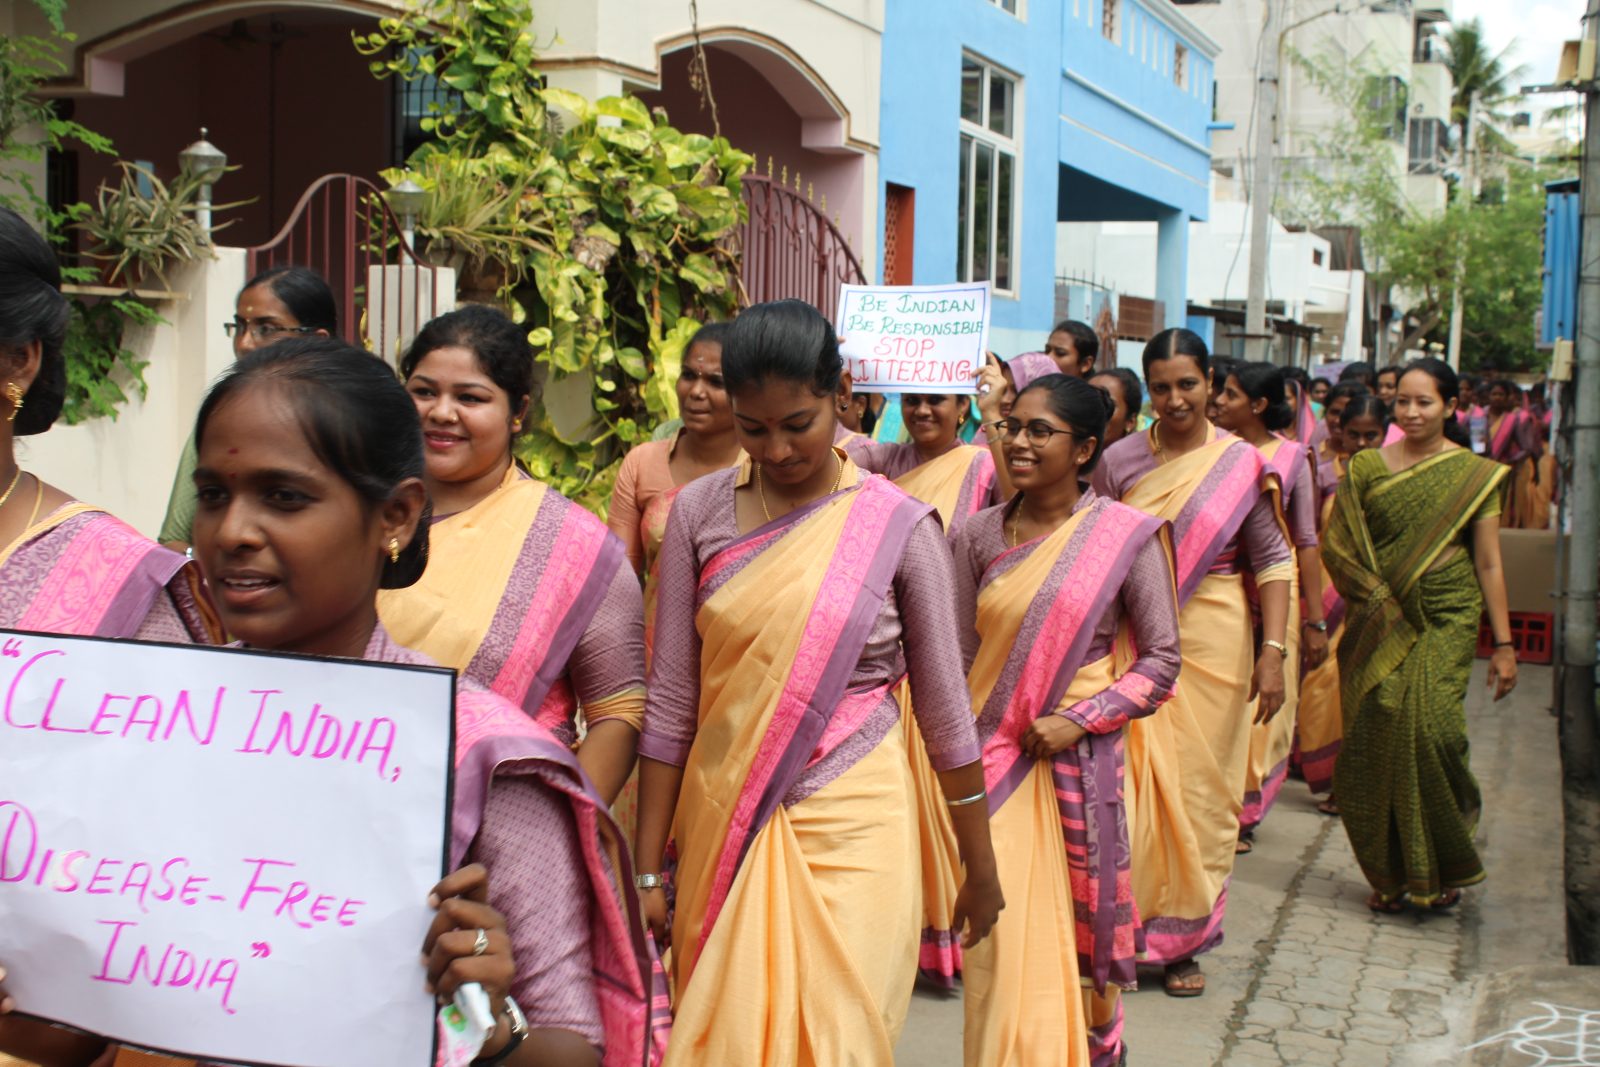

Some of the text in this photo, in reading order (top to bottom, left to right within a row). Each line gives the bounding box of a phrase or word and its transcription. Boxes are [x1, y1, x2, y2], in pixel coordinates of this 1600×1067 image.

[860, 295, 975, 313] BE INDIAN
[847, 315, 983, 335] BE RESPONSIBLE
[874, 336, 935, 358] STOP
[848, 358, 972, 383] LITTERING
